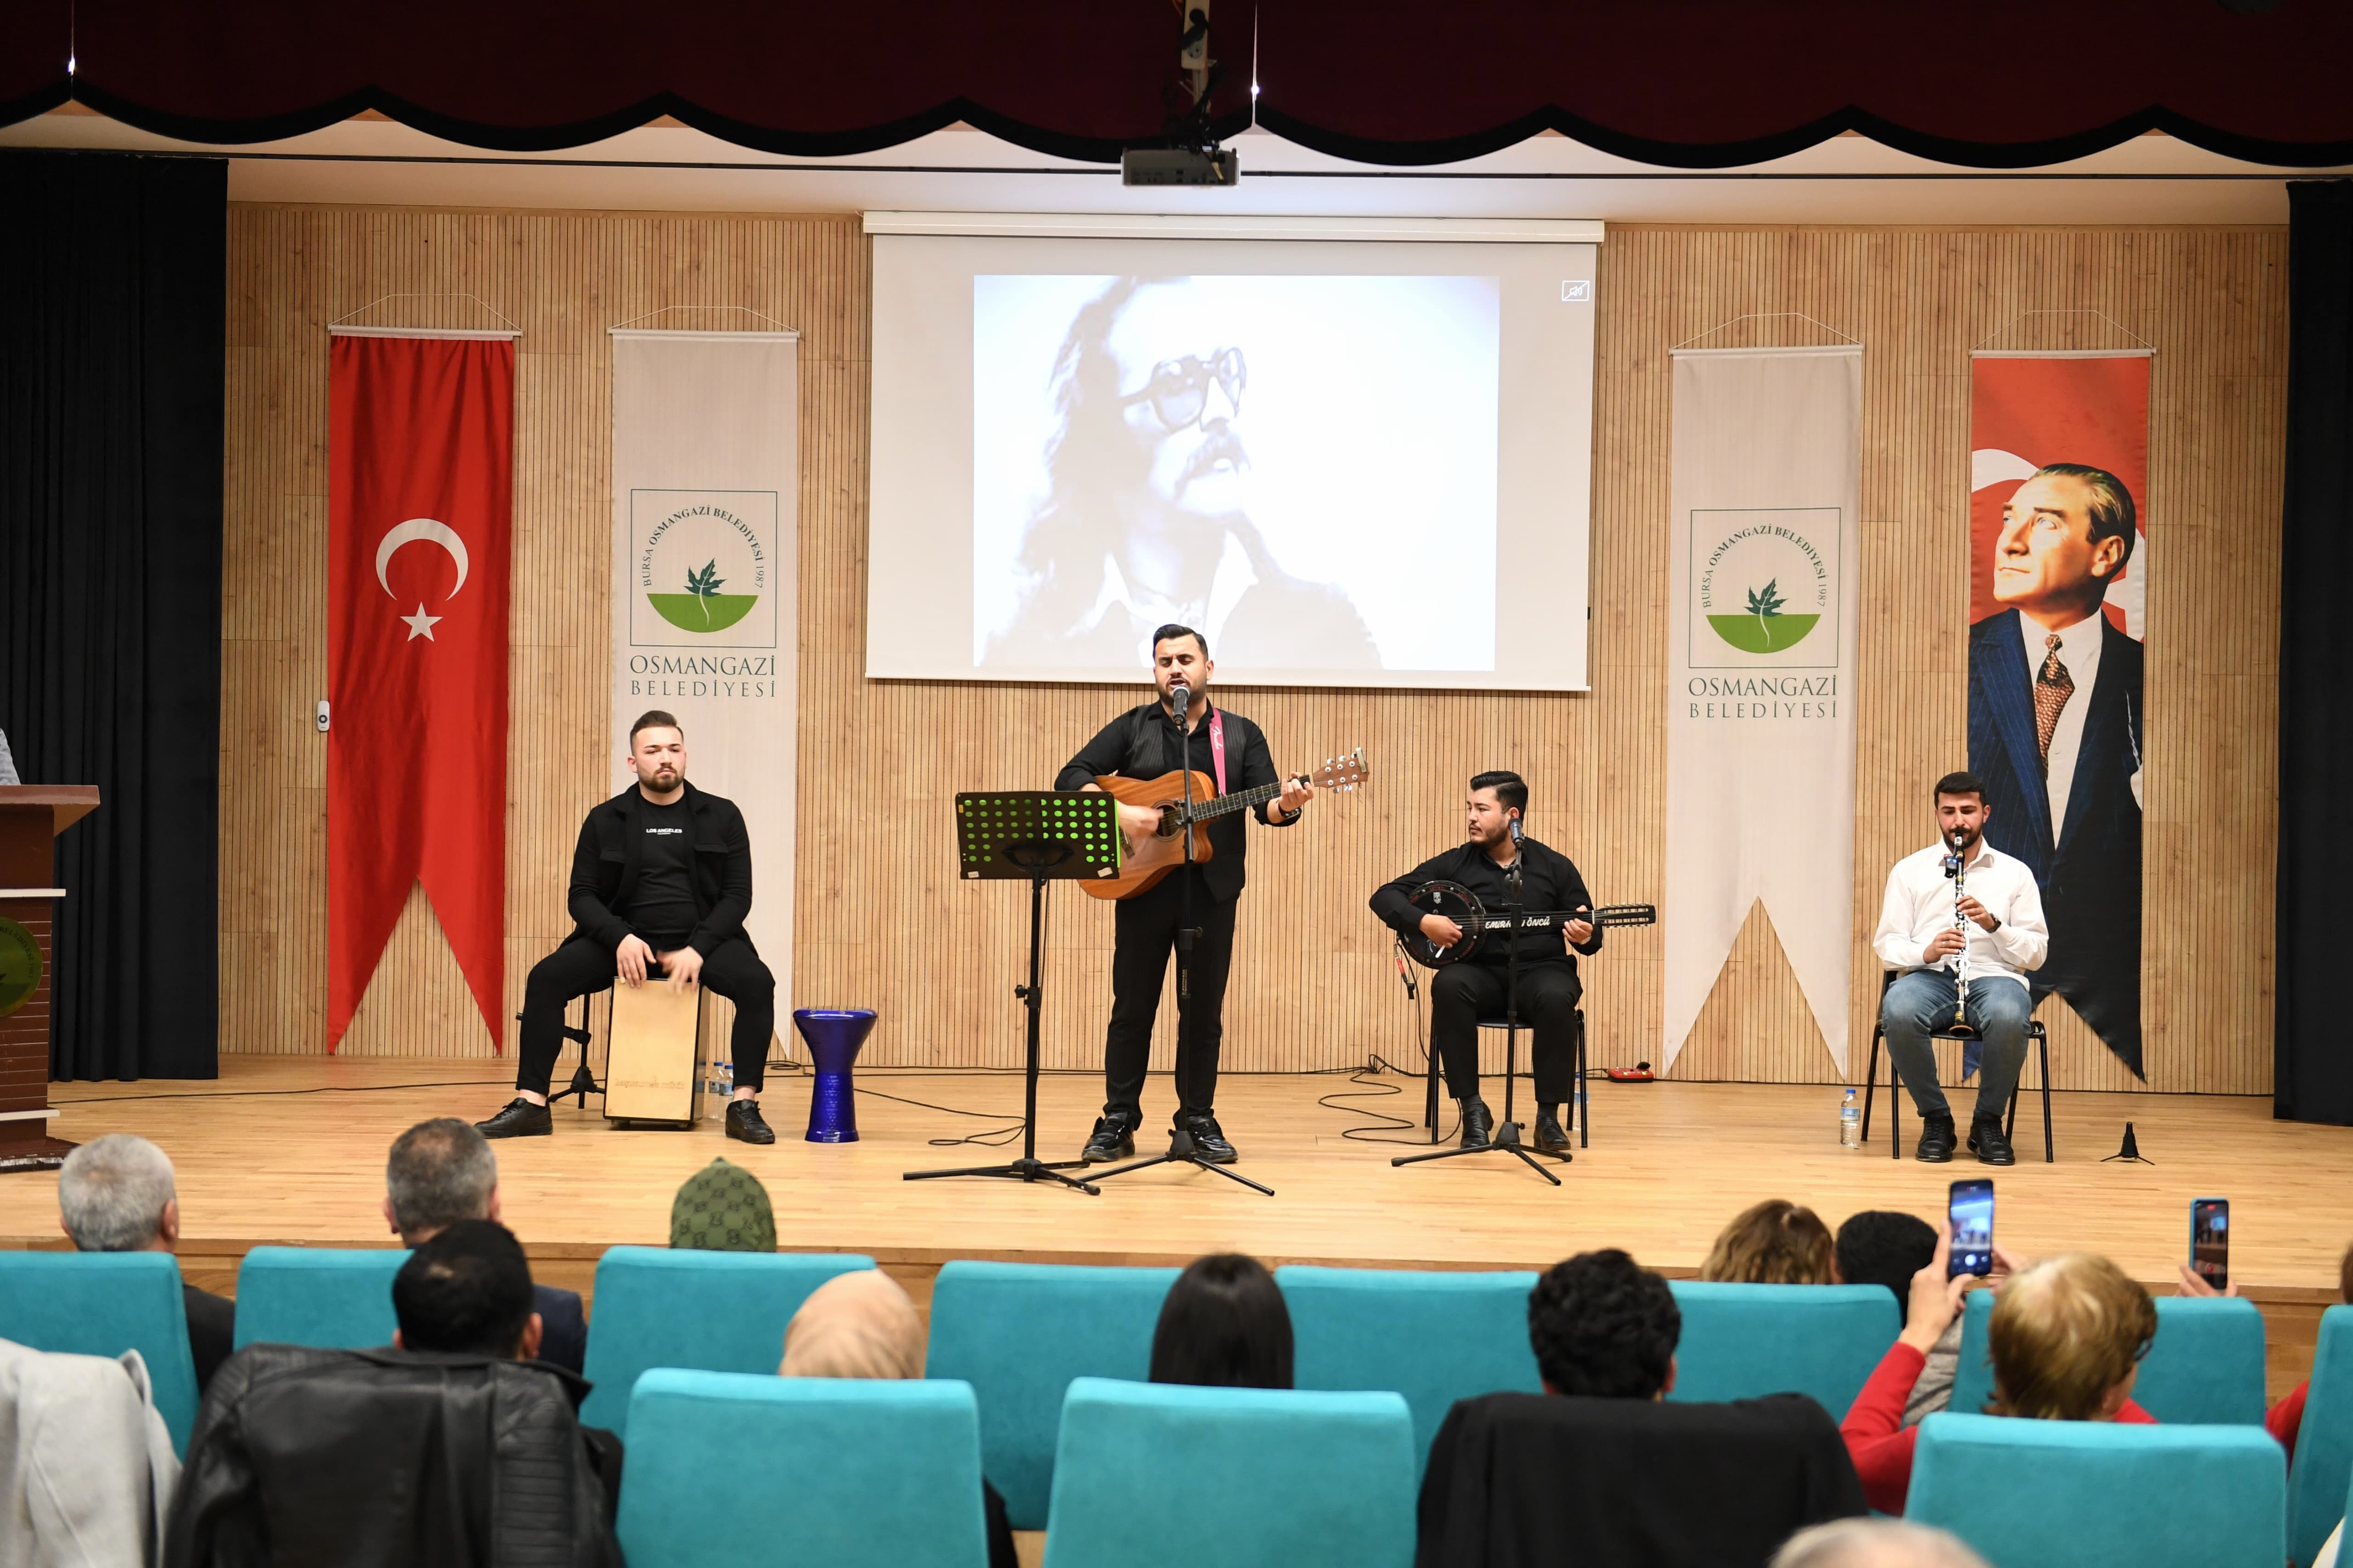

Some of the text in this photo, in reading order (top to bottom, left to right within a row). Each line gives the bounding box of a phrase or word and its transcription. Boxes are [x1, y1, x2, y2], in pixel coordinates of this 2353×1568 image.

[642, 505, 765, 589] BURSA OSMANGAZİ BELEDİYESİ 1987
[1702, 524, 1828, 608] BURSA OSMANGAZİ BELEDİYESİ 1987
[630, 655, 775, 676] OSMANGAZİ
[631, 680, 775, 698] BELEDİYESİ
[1688, 675, 1837, 696] OSMANGAZİ
[1689, 700, 1837, 718] BELEDİYESİ
[1526, 916, 1551, 927] ÖNCÜ
